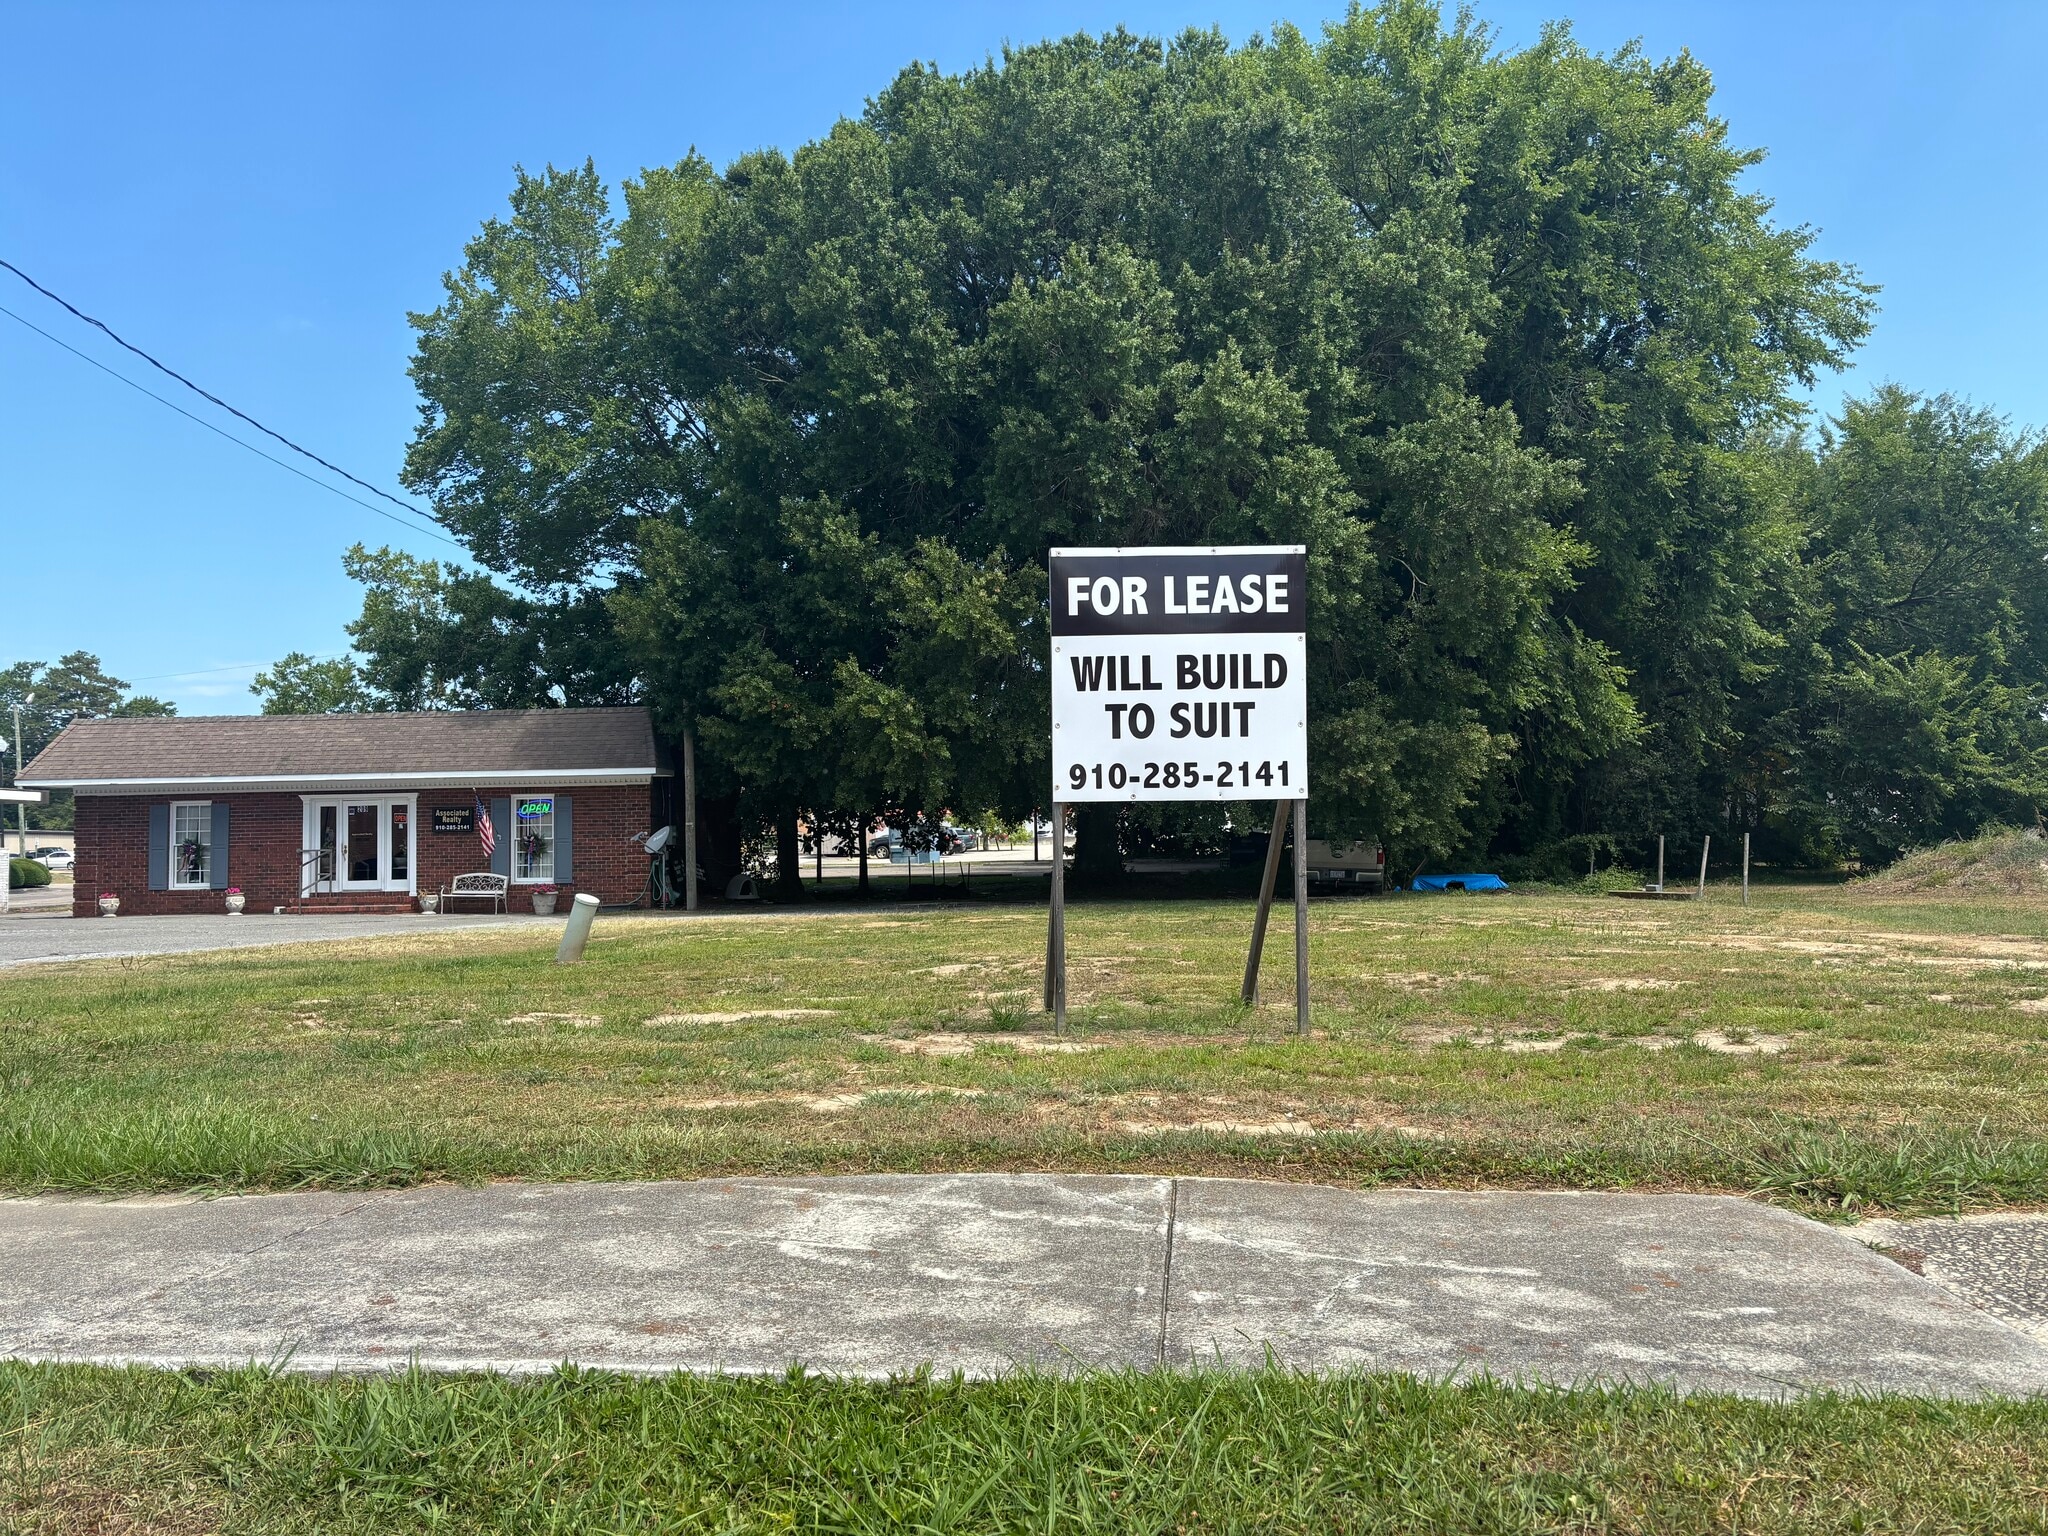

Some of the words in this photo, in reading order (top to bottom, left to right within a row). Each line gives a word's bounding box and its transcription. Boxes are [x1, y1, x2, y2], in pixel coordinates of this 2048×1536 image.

[1068, 576, 1149, 616] FOR
[1164, 574, 1289, 614] LEASE
[1070, 655, 1162, 692] WILL
[1176, 653, 1288, 690] BUILD
[1105, 703, 1155, 739] TO
[1170, 702, 1255, 738] SUIT
[1069, 761, 1289, 790] 910-285-2141
[435, 809, 469, 817] Associated
[442, 816, 462, 824] Realty
[521, 803, 550, 815] OPEN
